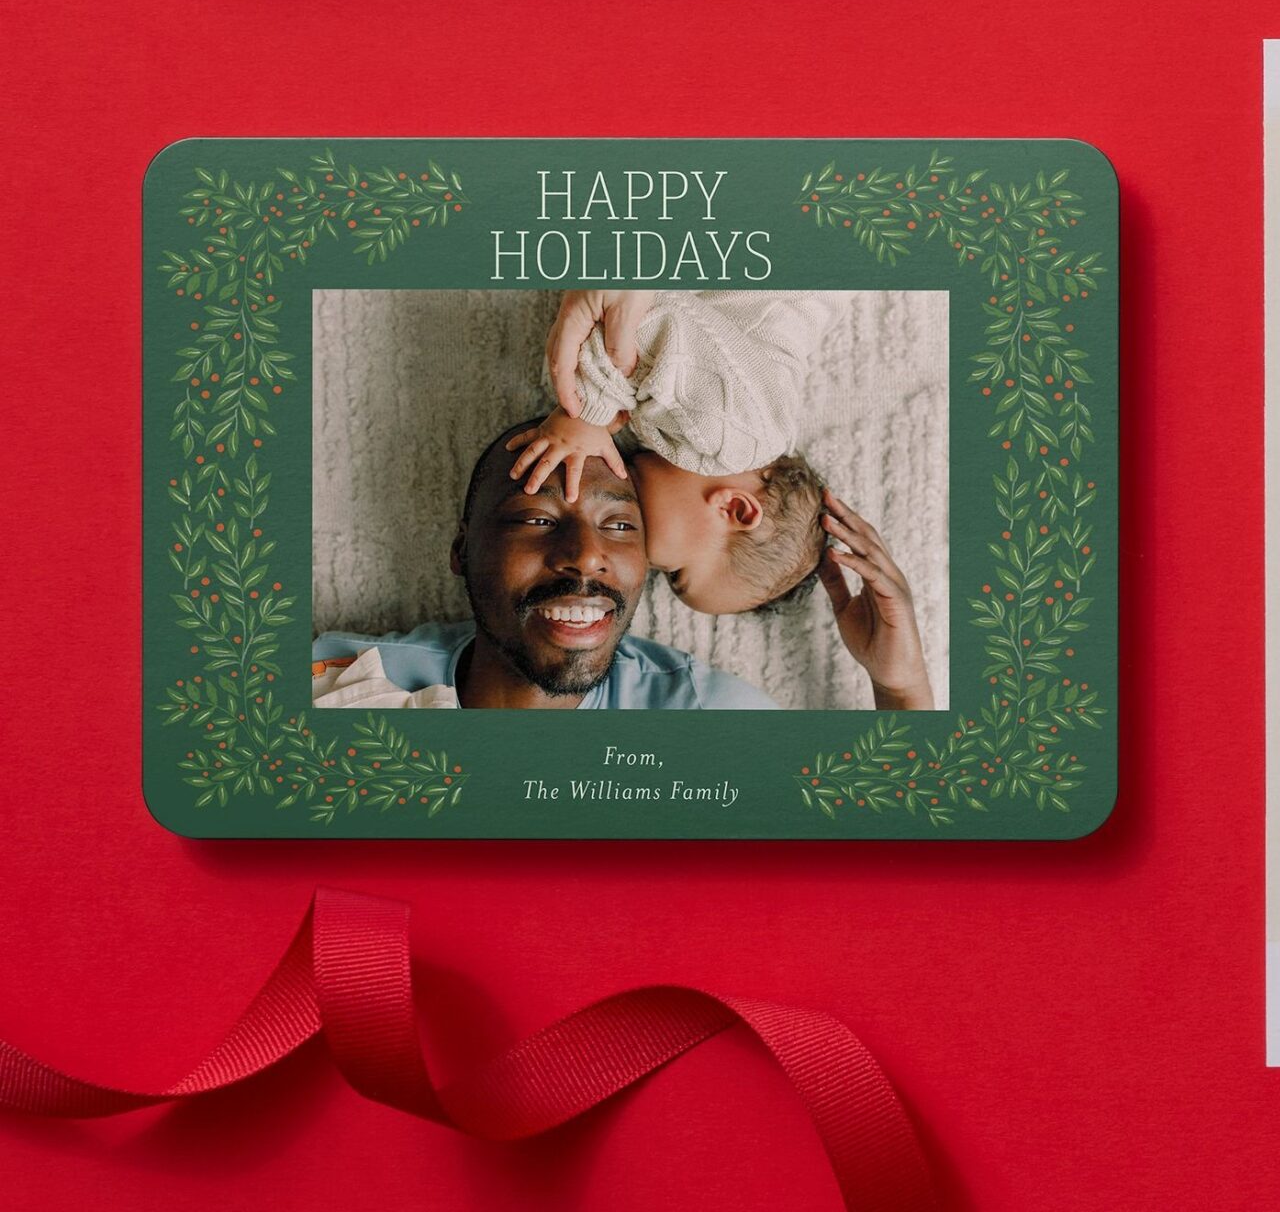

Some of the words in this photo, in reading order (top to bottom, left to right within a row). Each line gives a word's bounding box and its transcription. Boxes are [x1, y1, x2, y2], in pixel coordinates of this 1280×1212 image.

[536, 170, 728, 221] HAPPY
[489, 230, 773, 281] HOLIDAYS
[603, 745, 664, 769] From,
[522, 780, 560, 801] The
[569, 780, 662, 801] Williams
[669, 780, 739, 808] Family
